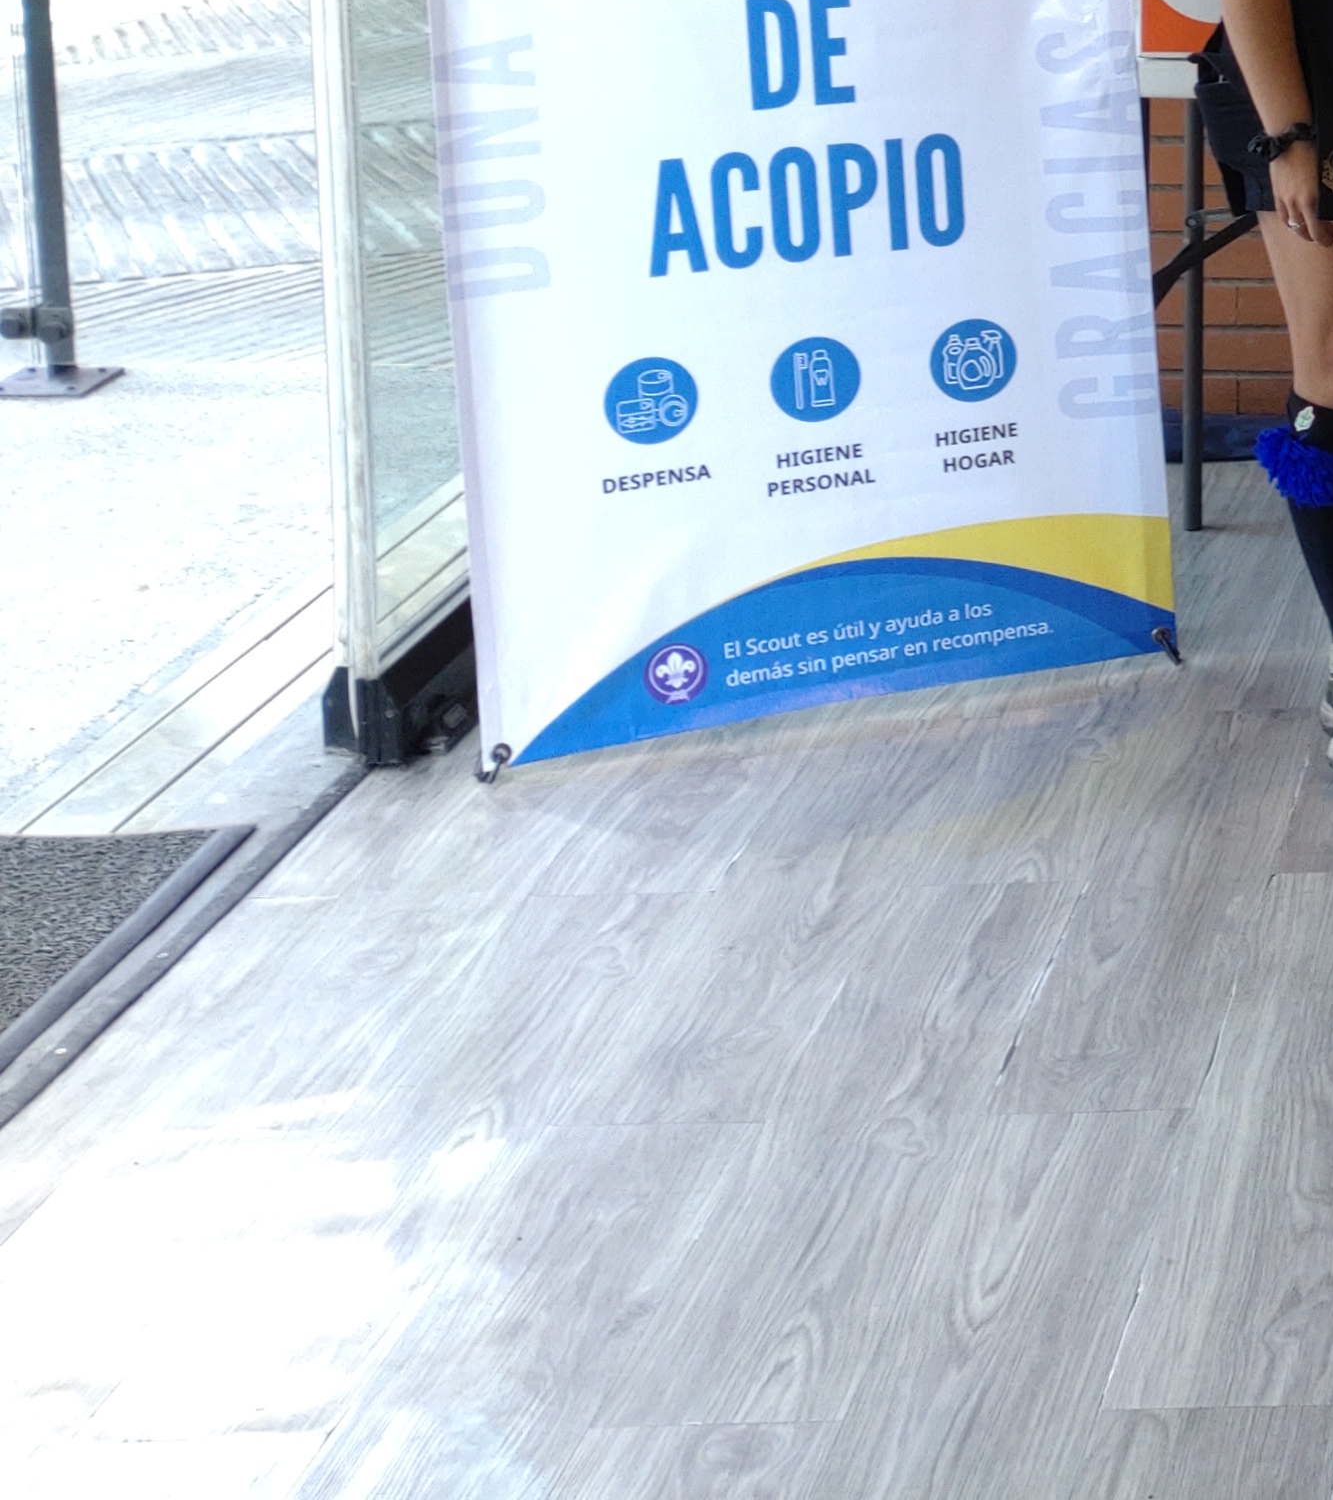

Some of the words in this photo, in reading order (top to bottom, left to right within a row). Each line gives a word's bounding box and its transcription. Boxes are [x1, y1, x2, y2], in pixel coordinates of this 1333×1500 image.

[649, 133, 966, 278] ACOPIO
[1034, 28, 1162, 421] GRACIAS
[934, 422, 1019, 448] HIGIENE
[775, 443, 864, 469] HIGIENE
[942, 449, 1016, 473] HOGAR
[602, 464, 712, 494] DESPENSA
[767, 467, 876, 497] PERSONAL
[723, 640, 741, 659] El
[745, 632, 802, 656] Scout
[806, 629, 829, 645] es
[833, 620, 865, 641] útil
[867, 620, 881, 640] y
[885, 609, 944, 635] ayuda
[948, 608, 960, 621] a
[964, 603, 993, 619] los
[726, 661, 794, 687] demás
[797, 655, 827, 675] sin
[831, 645, 900, 673] pensar
[904, 640, 928, 656] en
[933, 622, 1055, 652] recompensa.
